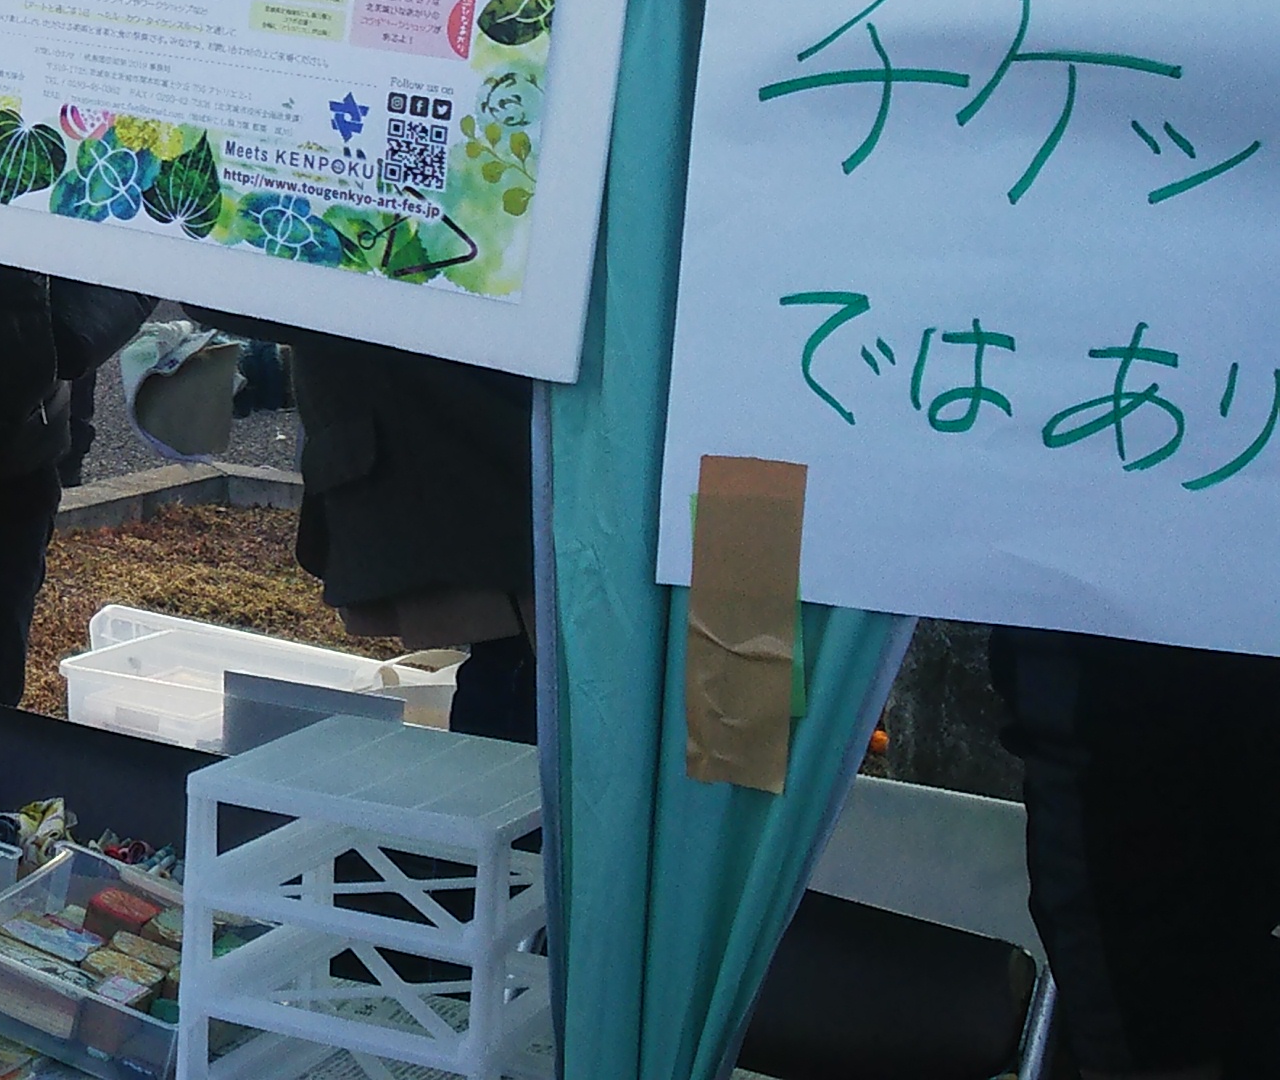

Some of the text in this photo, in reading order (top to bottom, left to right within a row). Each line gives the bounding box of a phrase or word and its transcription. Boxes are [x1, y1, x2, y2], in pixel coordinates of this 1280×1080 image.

[390, 77, 425, 90] Follow
[225, 139, 375, 180] Meets KENPOKU
[223, 167, 440, 219] http://www.tougenkyo-art-fes.jp
[780, 291, 1280, 491] ではあり
